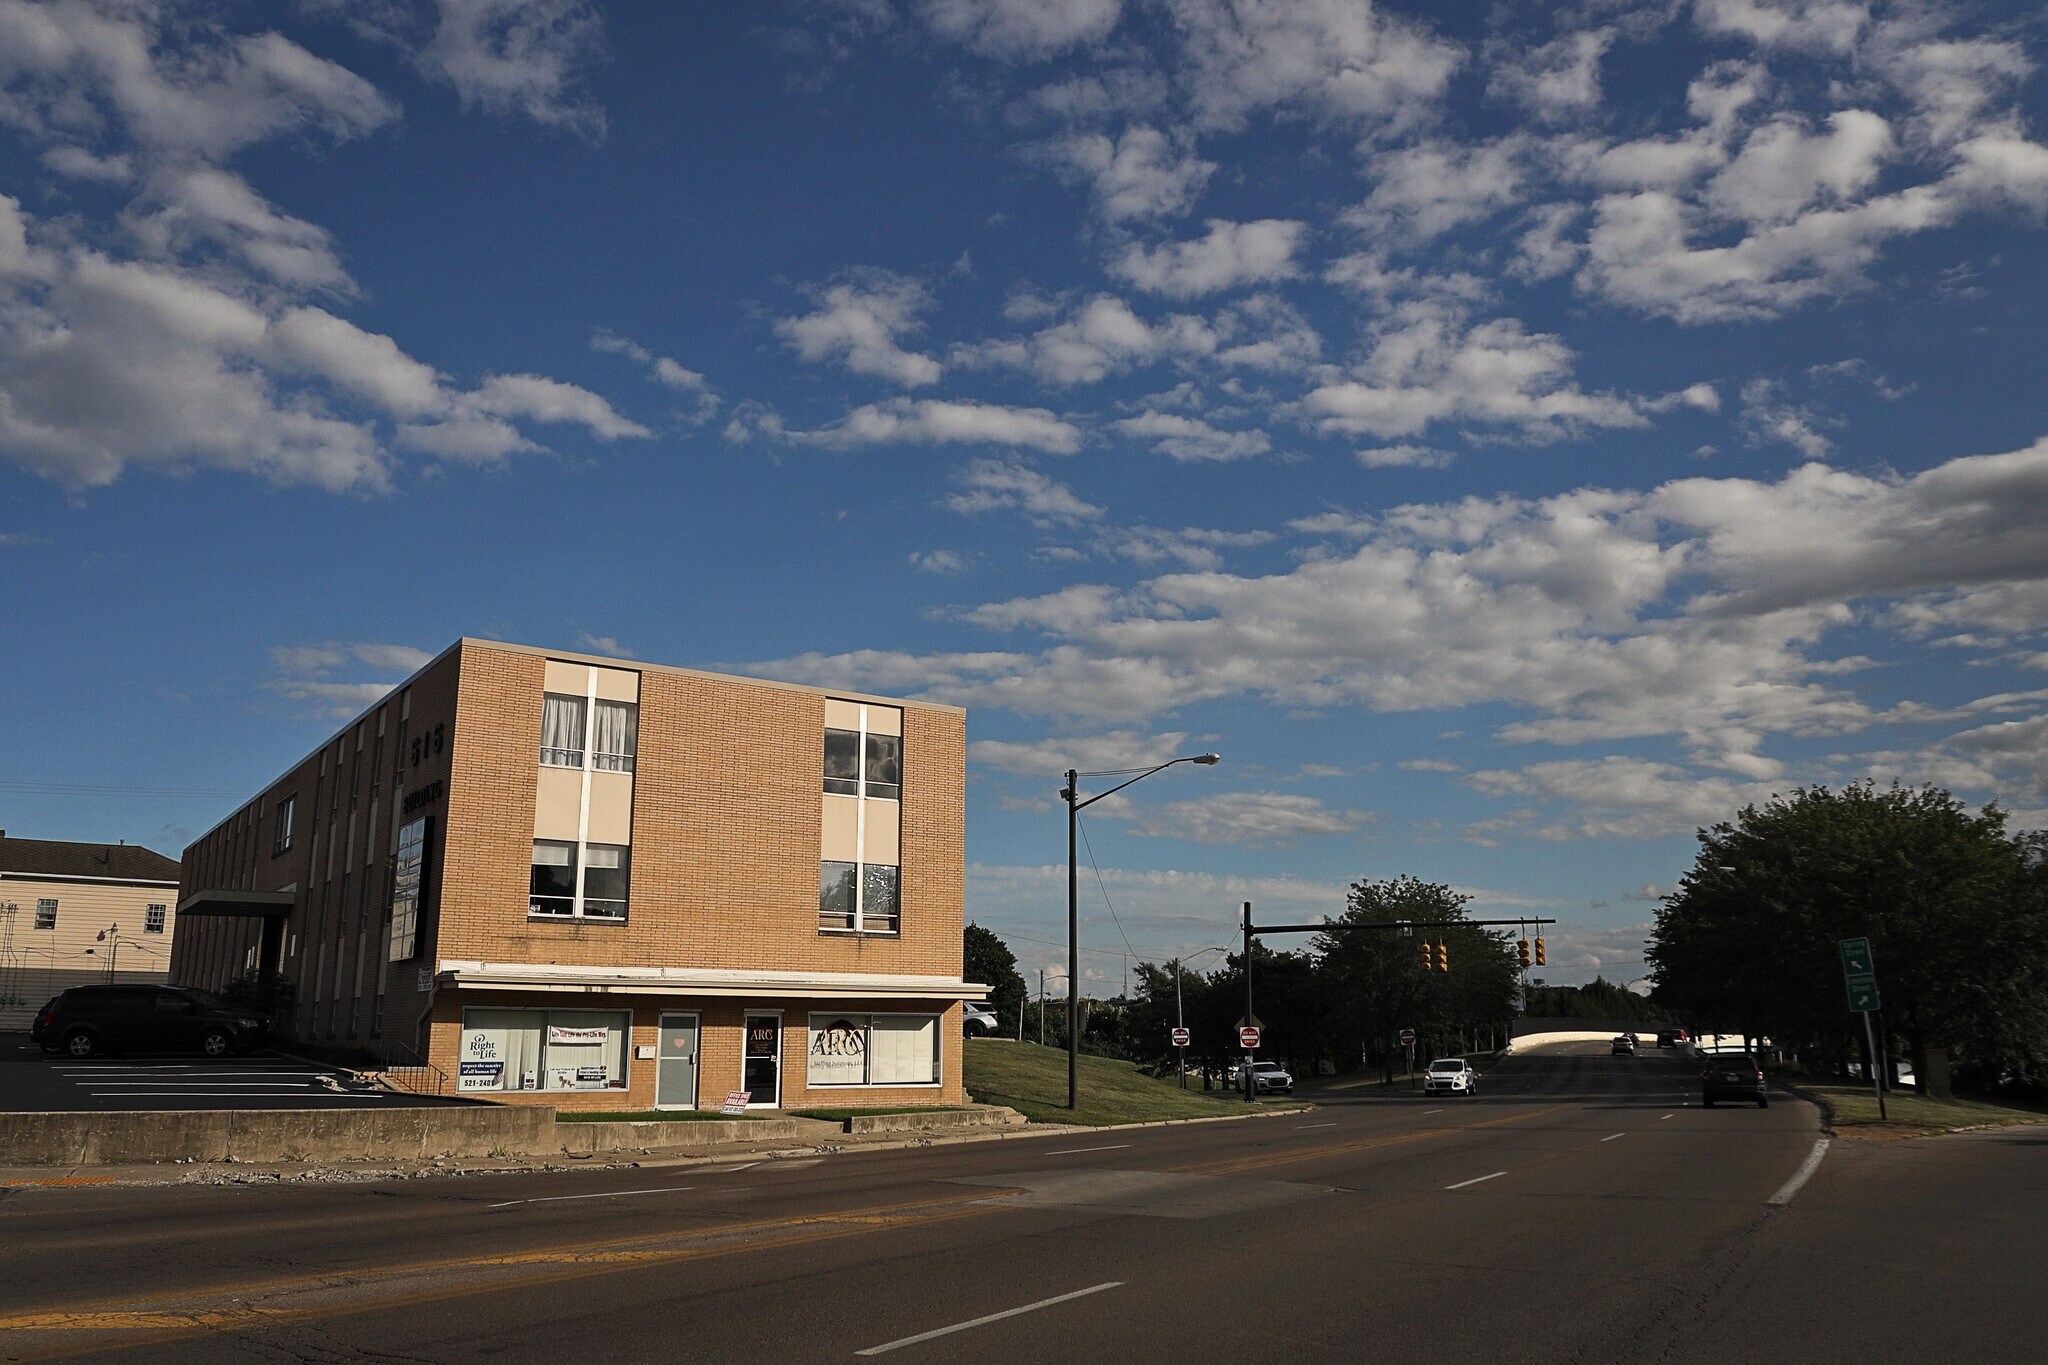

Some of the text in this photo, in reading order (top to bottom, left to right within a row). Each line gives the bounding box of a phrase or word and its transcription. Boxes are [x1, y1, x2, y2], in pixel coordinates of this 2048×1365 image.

[470, 1041, 495, 1051] Right
[480, 1049, 497, 1059] Life
[464, 1079, 495, 1087] 521-2401
[726, 1098, 748, 1106] AVAILABLE
